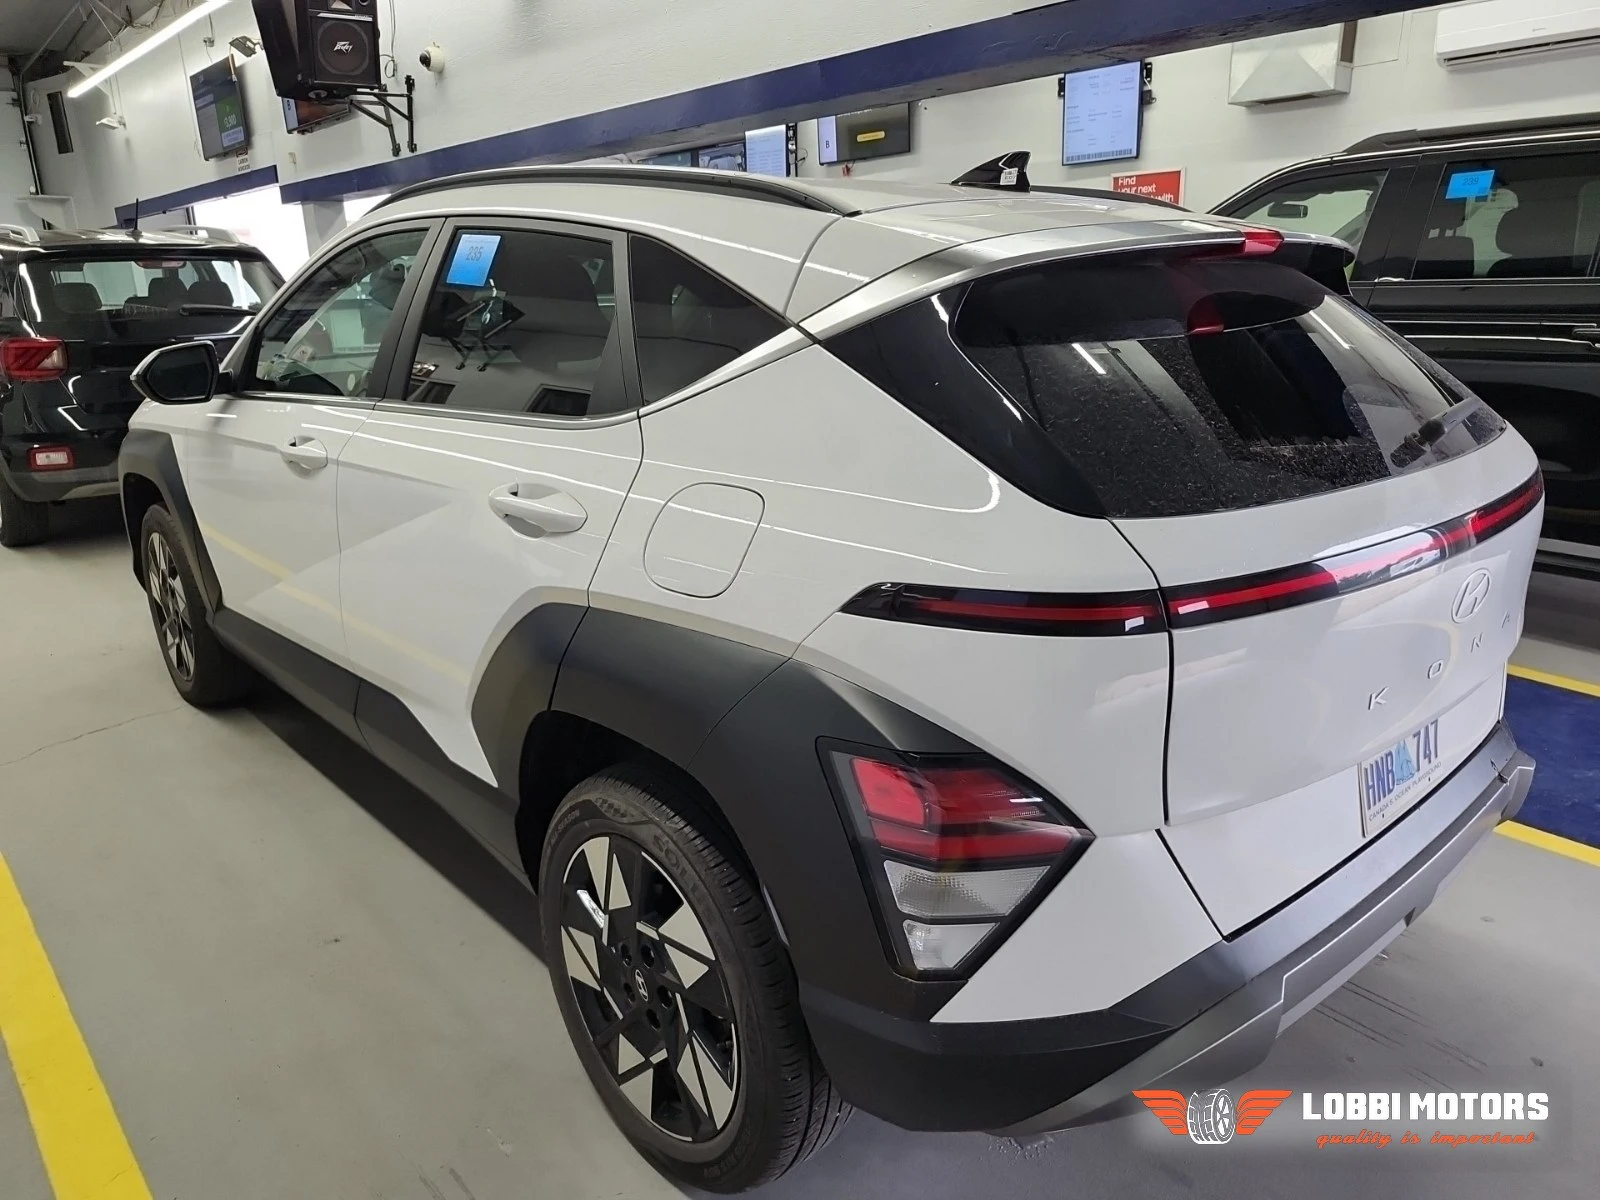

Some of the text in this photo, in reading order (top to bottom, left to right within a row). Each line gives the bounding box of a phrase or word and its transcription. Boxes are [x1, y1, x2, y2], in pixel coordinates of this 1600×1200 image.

[1118, 176, 1136, 186] Find
[1138, 183, 1156, 194] next
[1363, 718, 1439, 811] HNB 747
